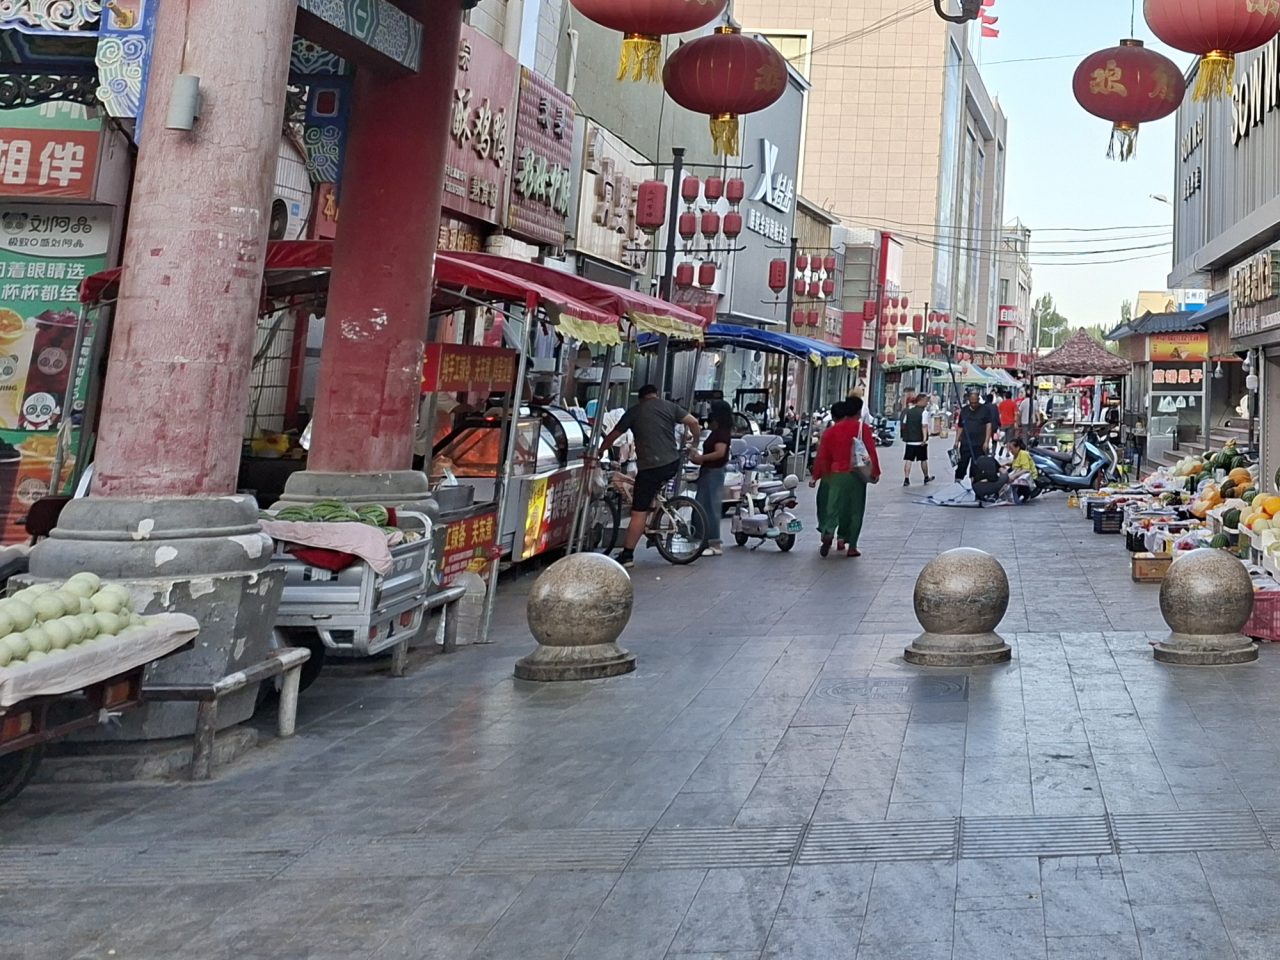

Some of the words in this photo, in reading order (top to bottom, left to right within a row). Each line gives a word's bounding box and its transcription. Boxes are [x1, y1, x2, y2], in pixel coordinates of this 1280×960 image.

[1, 282, 81, 302] 杯杯都经
[1152, 368, 1204, 385] 煎饼果子
